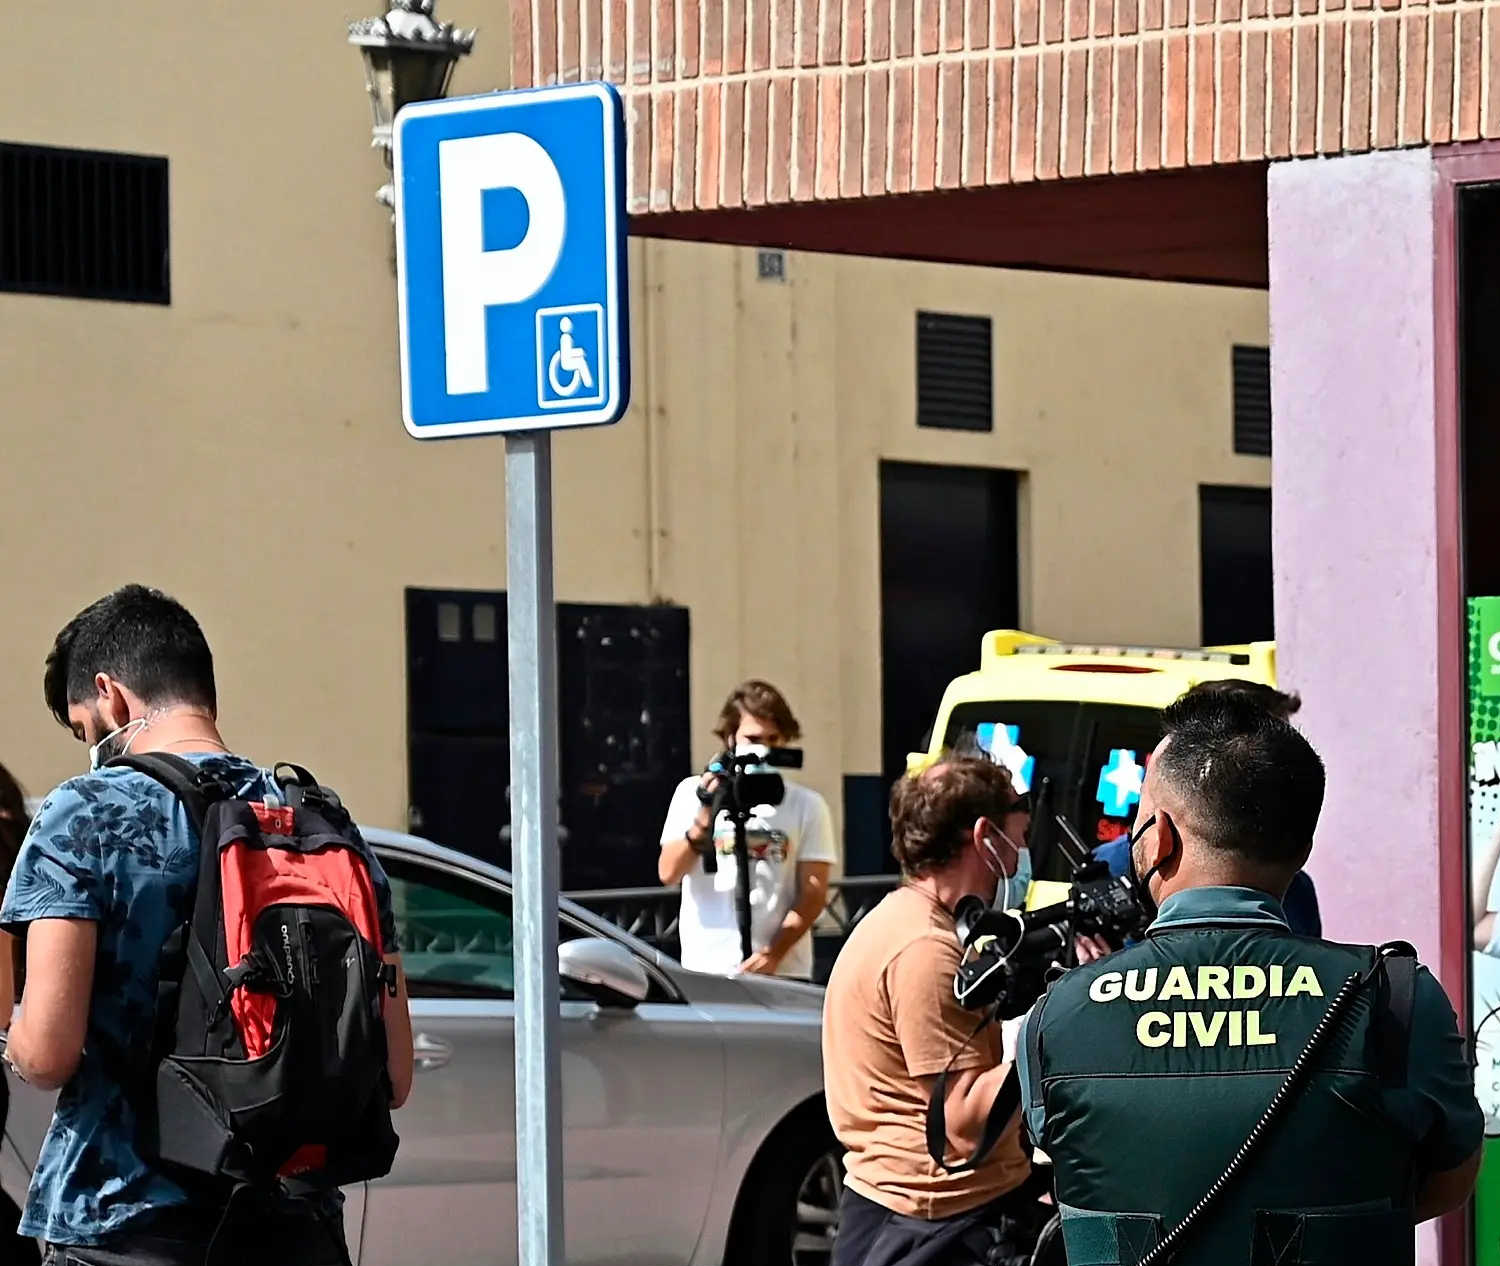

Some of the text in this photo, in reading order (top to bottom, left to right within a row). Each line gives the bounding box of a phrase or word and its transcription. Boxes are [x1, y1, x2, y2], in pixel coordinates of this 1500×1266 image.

[439, 132, 567, 395] P
[1088, 964, 1324, 1003] GUARDIA
[1136, 1010, 1277, 1048] CIVIL
[1491, 1103, 1500, 1117] y
